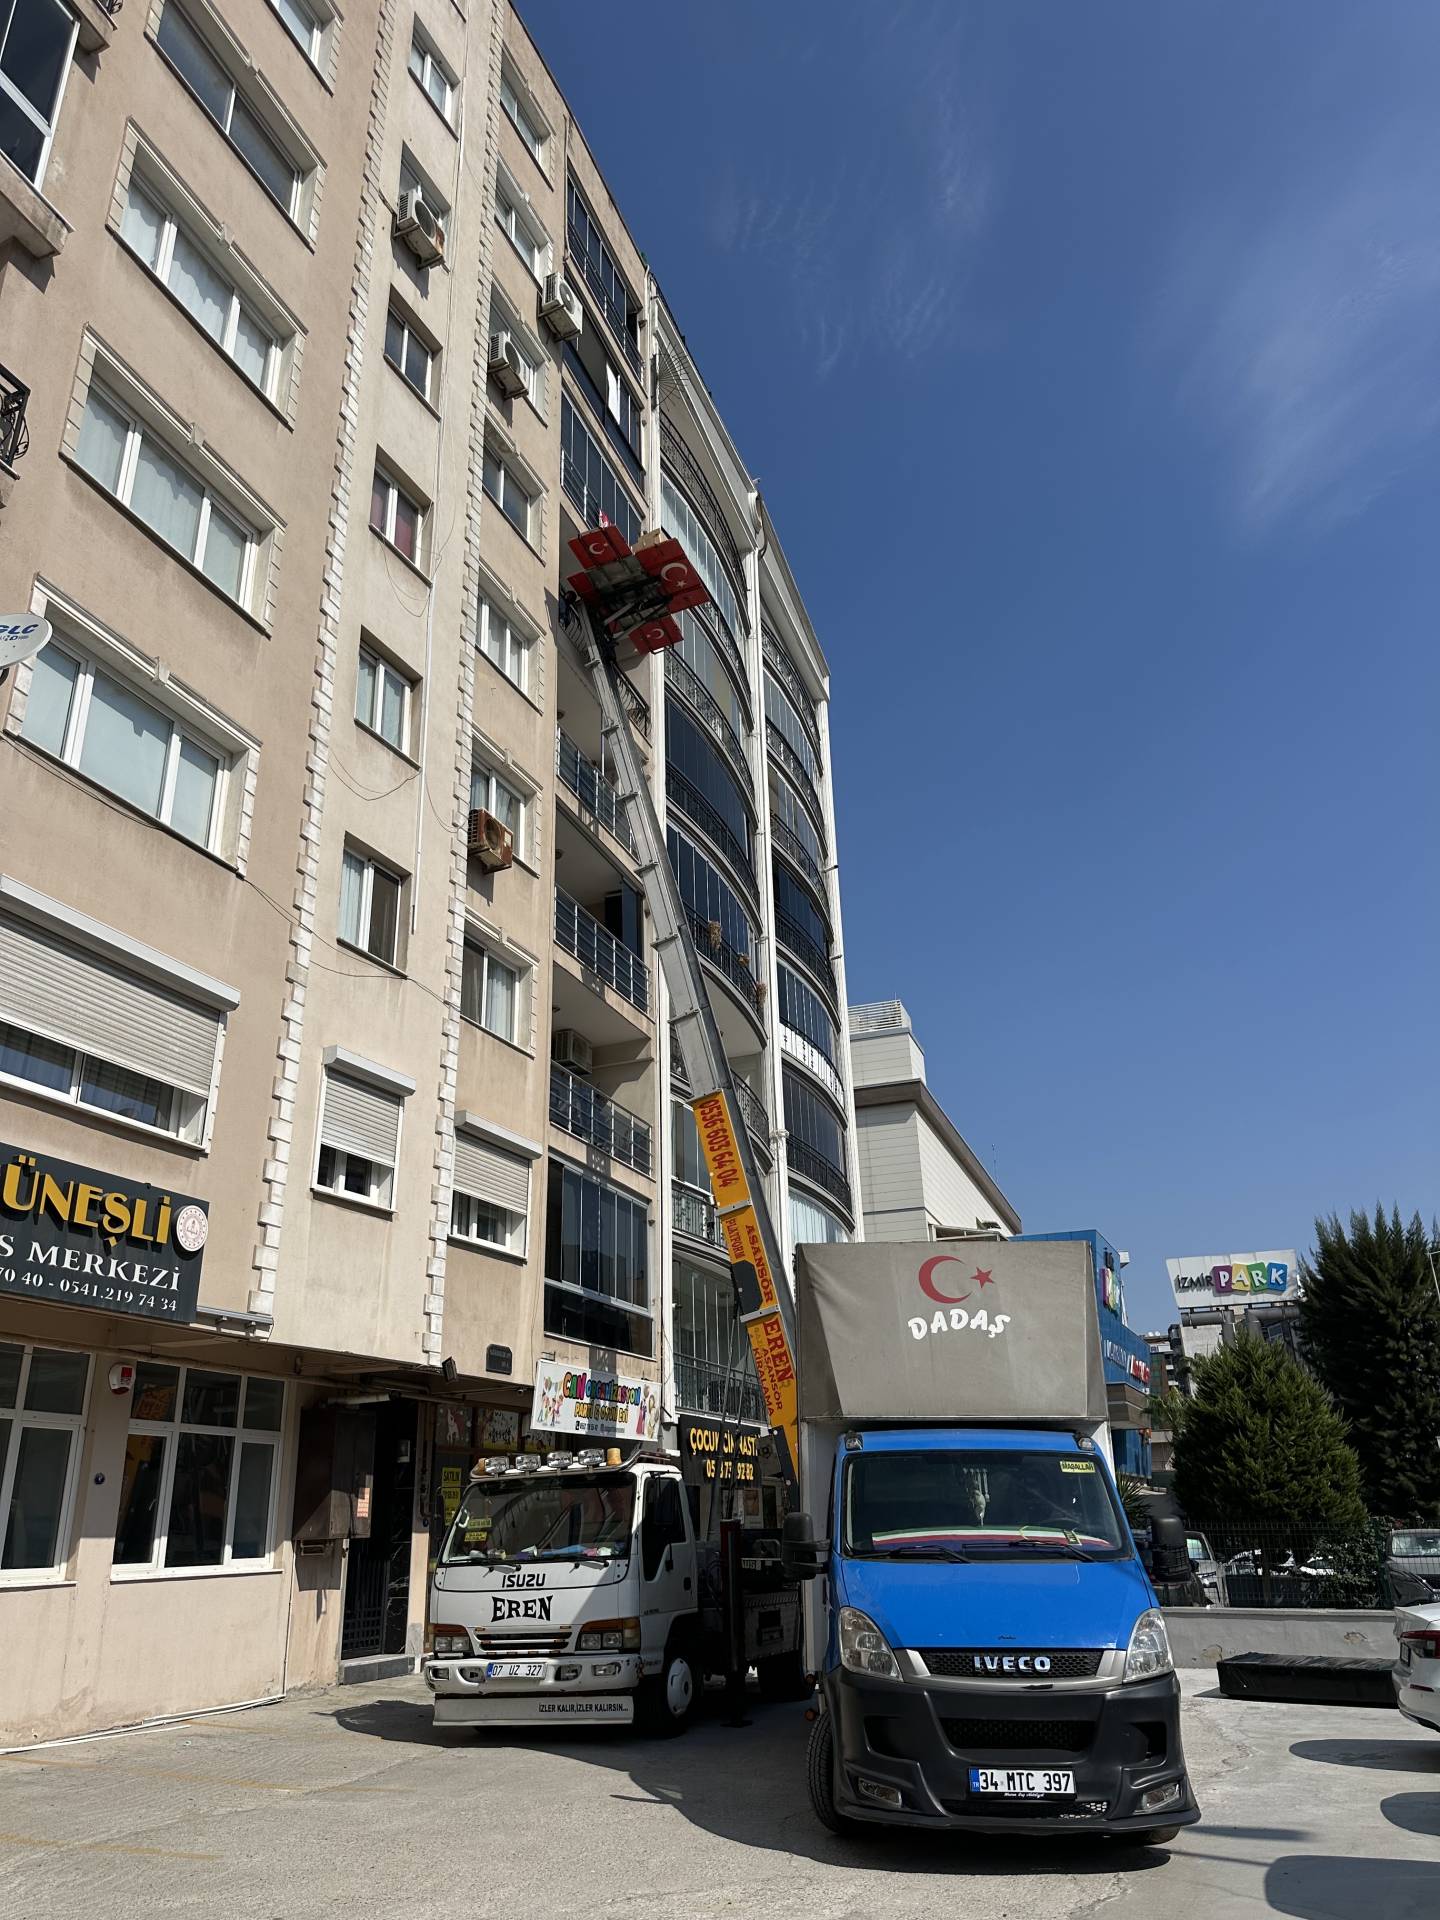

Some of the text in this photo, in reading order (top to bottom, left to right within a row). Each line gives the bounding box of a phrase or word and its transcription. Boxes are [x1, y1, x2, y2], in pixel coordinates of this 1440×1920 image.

[699, 1099, 739, 1188] 0536 603 64 04
[0, 1154, 171, 1247] ÜNEŞLİ
[726, 1218, 746, 1260] PLATFORM
[27, 1241, 180, 1291] MERKEZİ
[745, 1225, 774, 1303] ASANSÖR
[1176, 1267, 1284, 1289] İZMİR PARK
[22, 1272, 43, 1287] 40
[60, 1279, 133, 1303] 0541.219
[139, 1293, 155, 1307] 74
[161, 1298, 177, 1311] 34
[907, 1308, 1011, 1340] DADAŞ
[763, 1318, 795, 1383] EREN
[563, 1371, 642, 1406] CAN ORGANİZASYON
[753, 1347, 774, 1417] KİRALAMA
[763, 1349, 783, 1410] ASANSÖR
[502, 1573, 546, 1588] ISUZU
[491, 1595, 553, 1622] EREN
[493, 1665, 503, 1676] 07
[526, 1665, 542, 1676] 327
[974, 1656, 1051, 1672] IVECO
[980, 1772, 1071, 1792] 34 MTC 397
